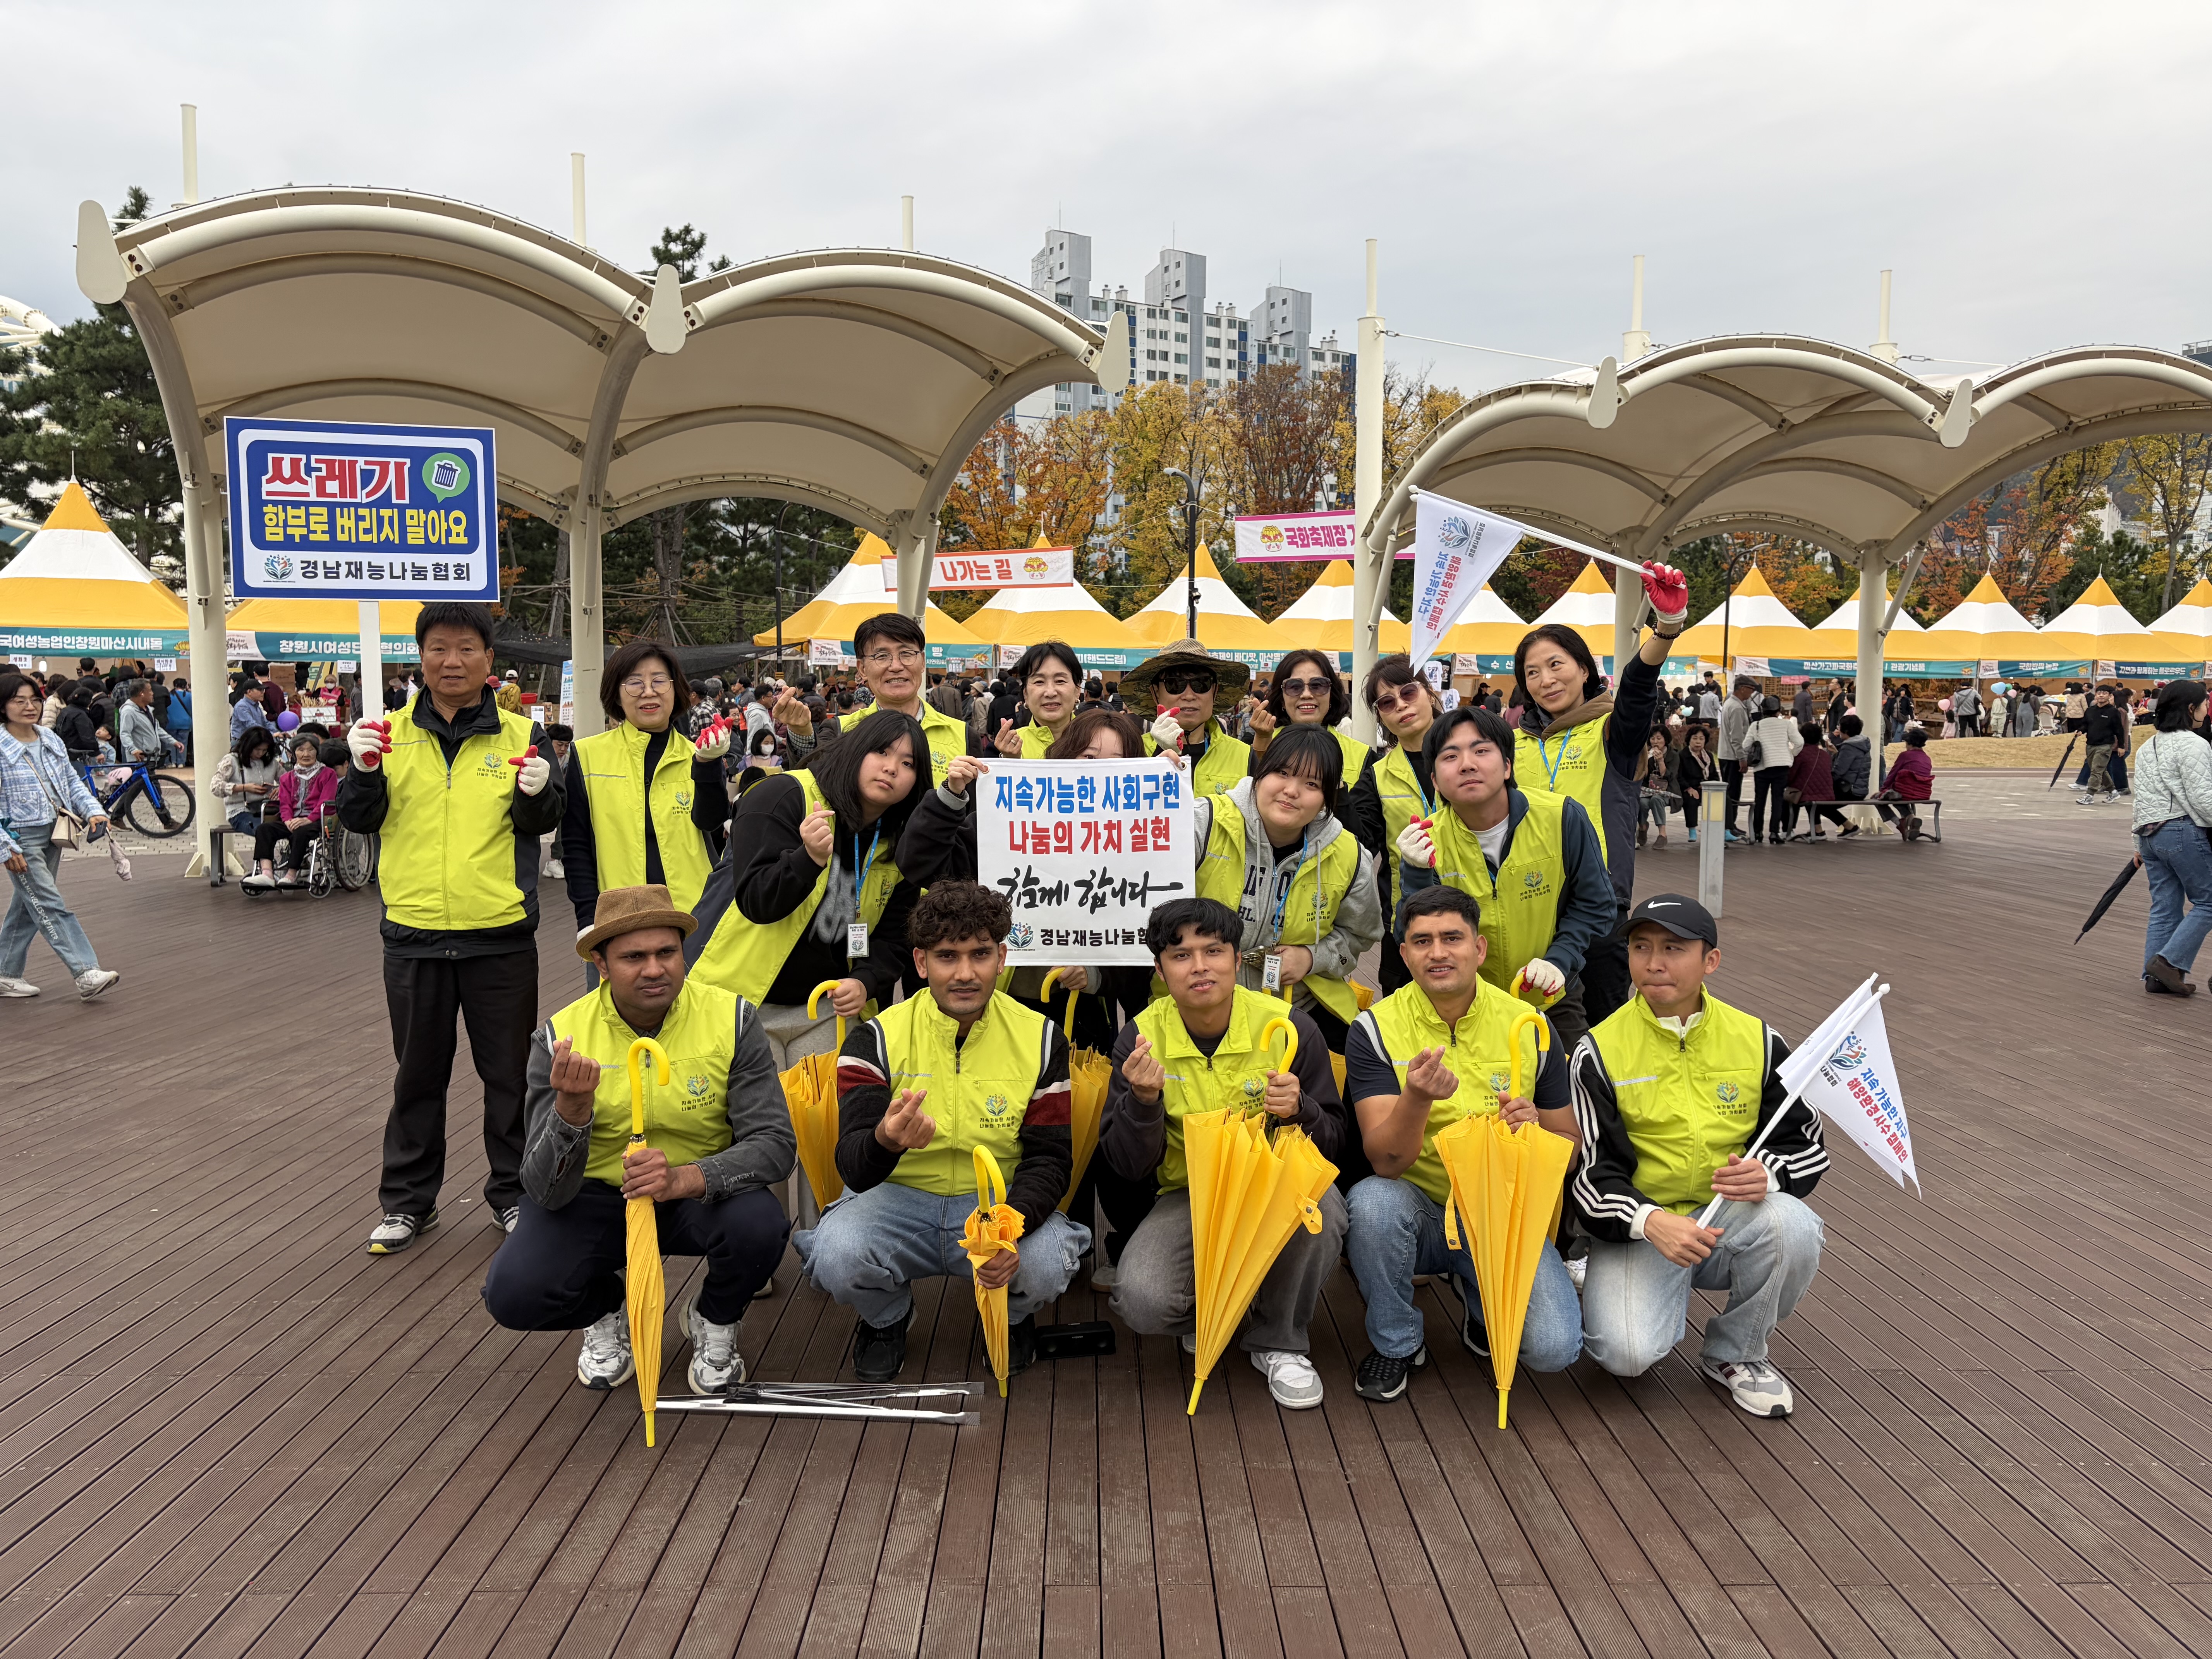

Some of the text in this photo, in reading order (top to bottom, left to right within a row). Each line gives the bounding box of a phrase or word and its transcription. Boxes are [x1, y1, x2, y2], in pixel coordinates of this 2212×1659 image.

[263, 454, 409, 503] 쓰레기
[263, 504, 468, 545] 함부로 버리지 말아요
[1284, 524, 1346, 548] 국화축제장
[300, 560, 471, 582] 경남재능나눔협회
[940, 559, 1013, 581] 나가는 길
[280, 640, 420, 654] 창원시여성단협의회
[1209, 652, 1233, 661] 축제의
[995, 771, 1180, 813] 지속가능한 사회구현
[1009, 816, 1171, 855] 나눔의 가치 실현
[997, 864, 1184, 915] 함께 합니다
[1040, 927, 1148, 947] 경남재능나눔협
[1819, 1066, 1838, 1087] 나눔협회
[1860, 1067, 1908, 1139] 지속 가능한 지구
[1847, 1077, 1908, 1163] 해양환경 사수 캠페인
